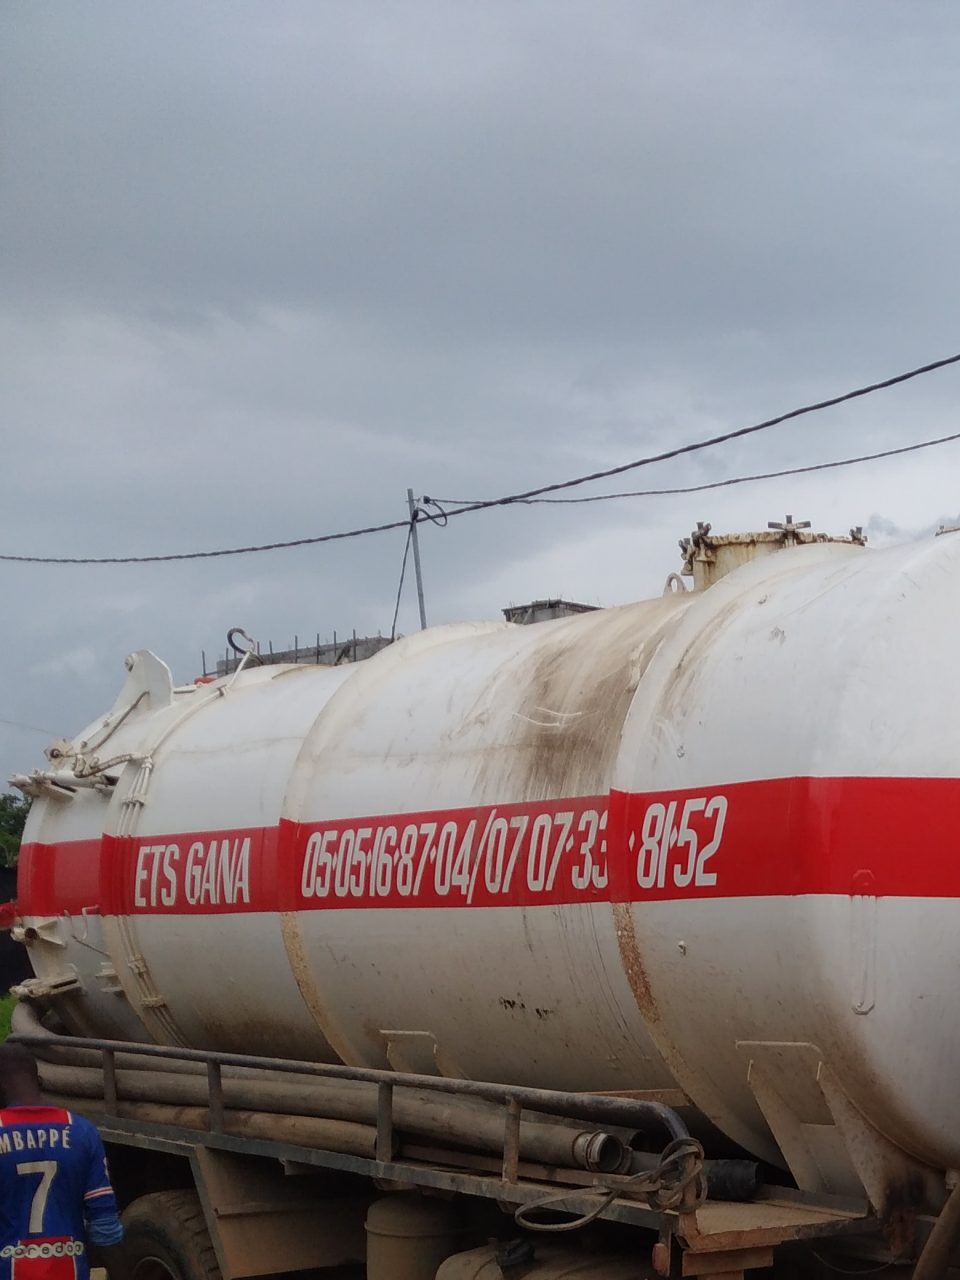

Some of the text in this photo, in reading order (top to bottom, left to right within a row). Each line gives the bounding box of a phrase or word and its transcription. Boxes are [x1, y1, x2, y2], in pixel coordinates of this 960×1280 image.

[134, 843, 180, 908] ETS
[185, 836, 251, 906] GANA
[0, 1126, 72, 1155] MBAPPÉ
[16, 1160, 58, 1234] 7
[2, 1242, 83, 1258] ooredoo
